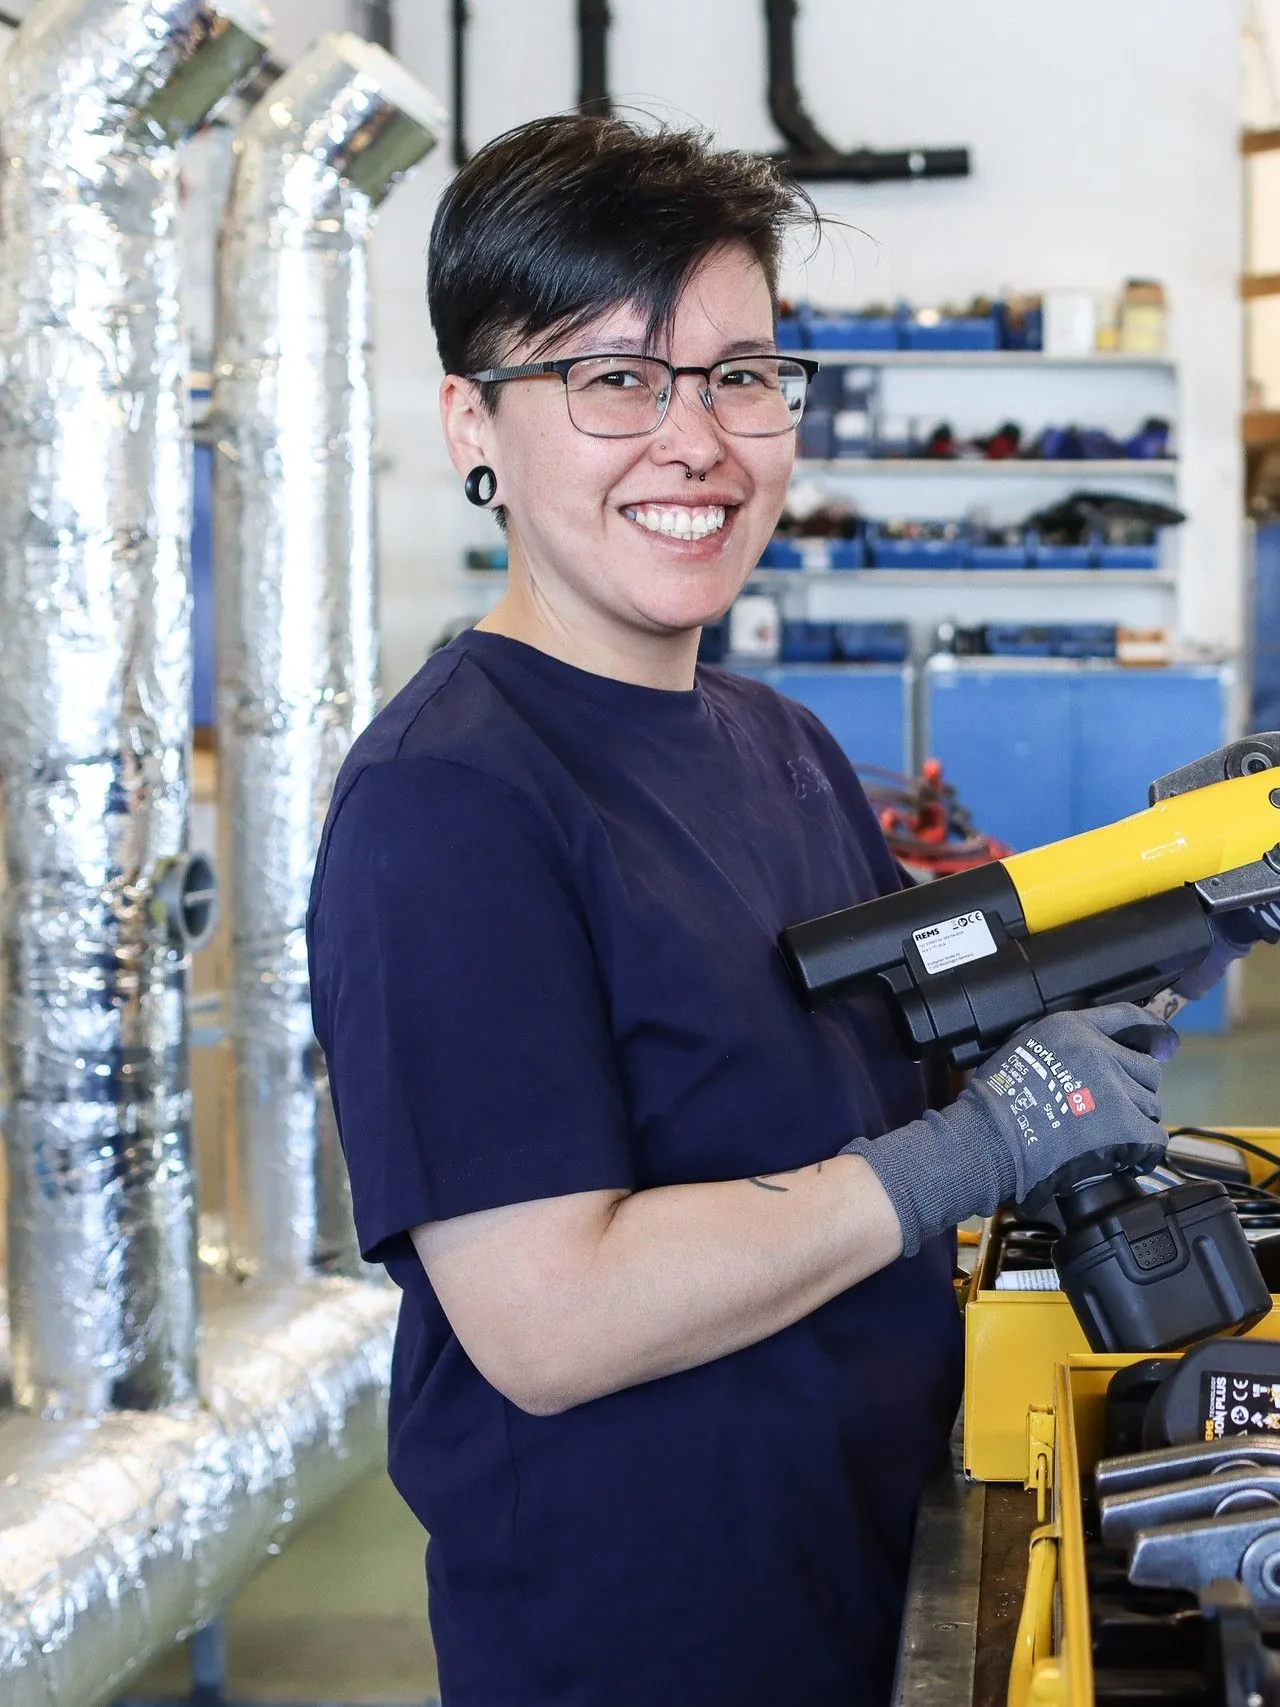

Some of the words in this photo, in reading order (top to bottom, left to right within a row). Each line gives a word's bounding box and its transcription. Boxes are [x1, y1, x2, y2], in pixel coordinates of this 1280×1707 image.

[915, 928, 940, 941] REMS
[1007, 1054, 1029, 1076] Chess
[1043, 1103, 1055, 1121] Size
[1051, 1120, 1061, 1129] 8
[1215, 1376, 1227, 1410] PLUS
[1205, 1419, 1214, 1442] EMS
